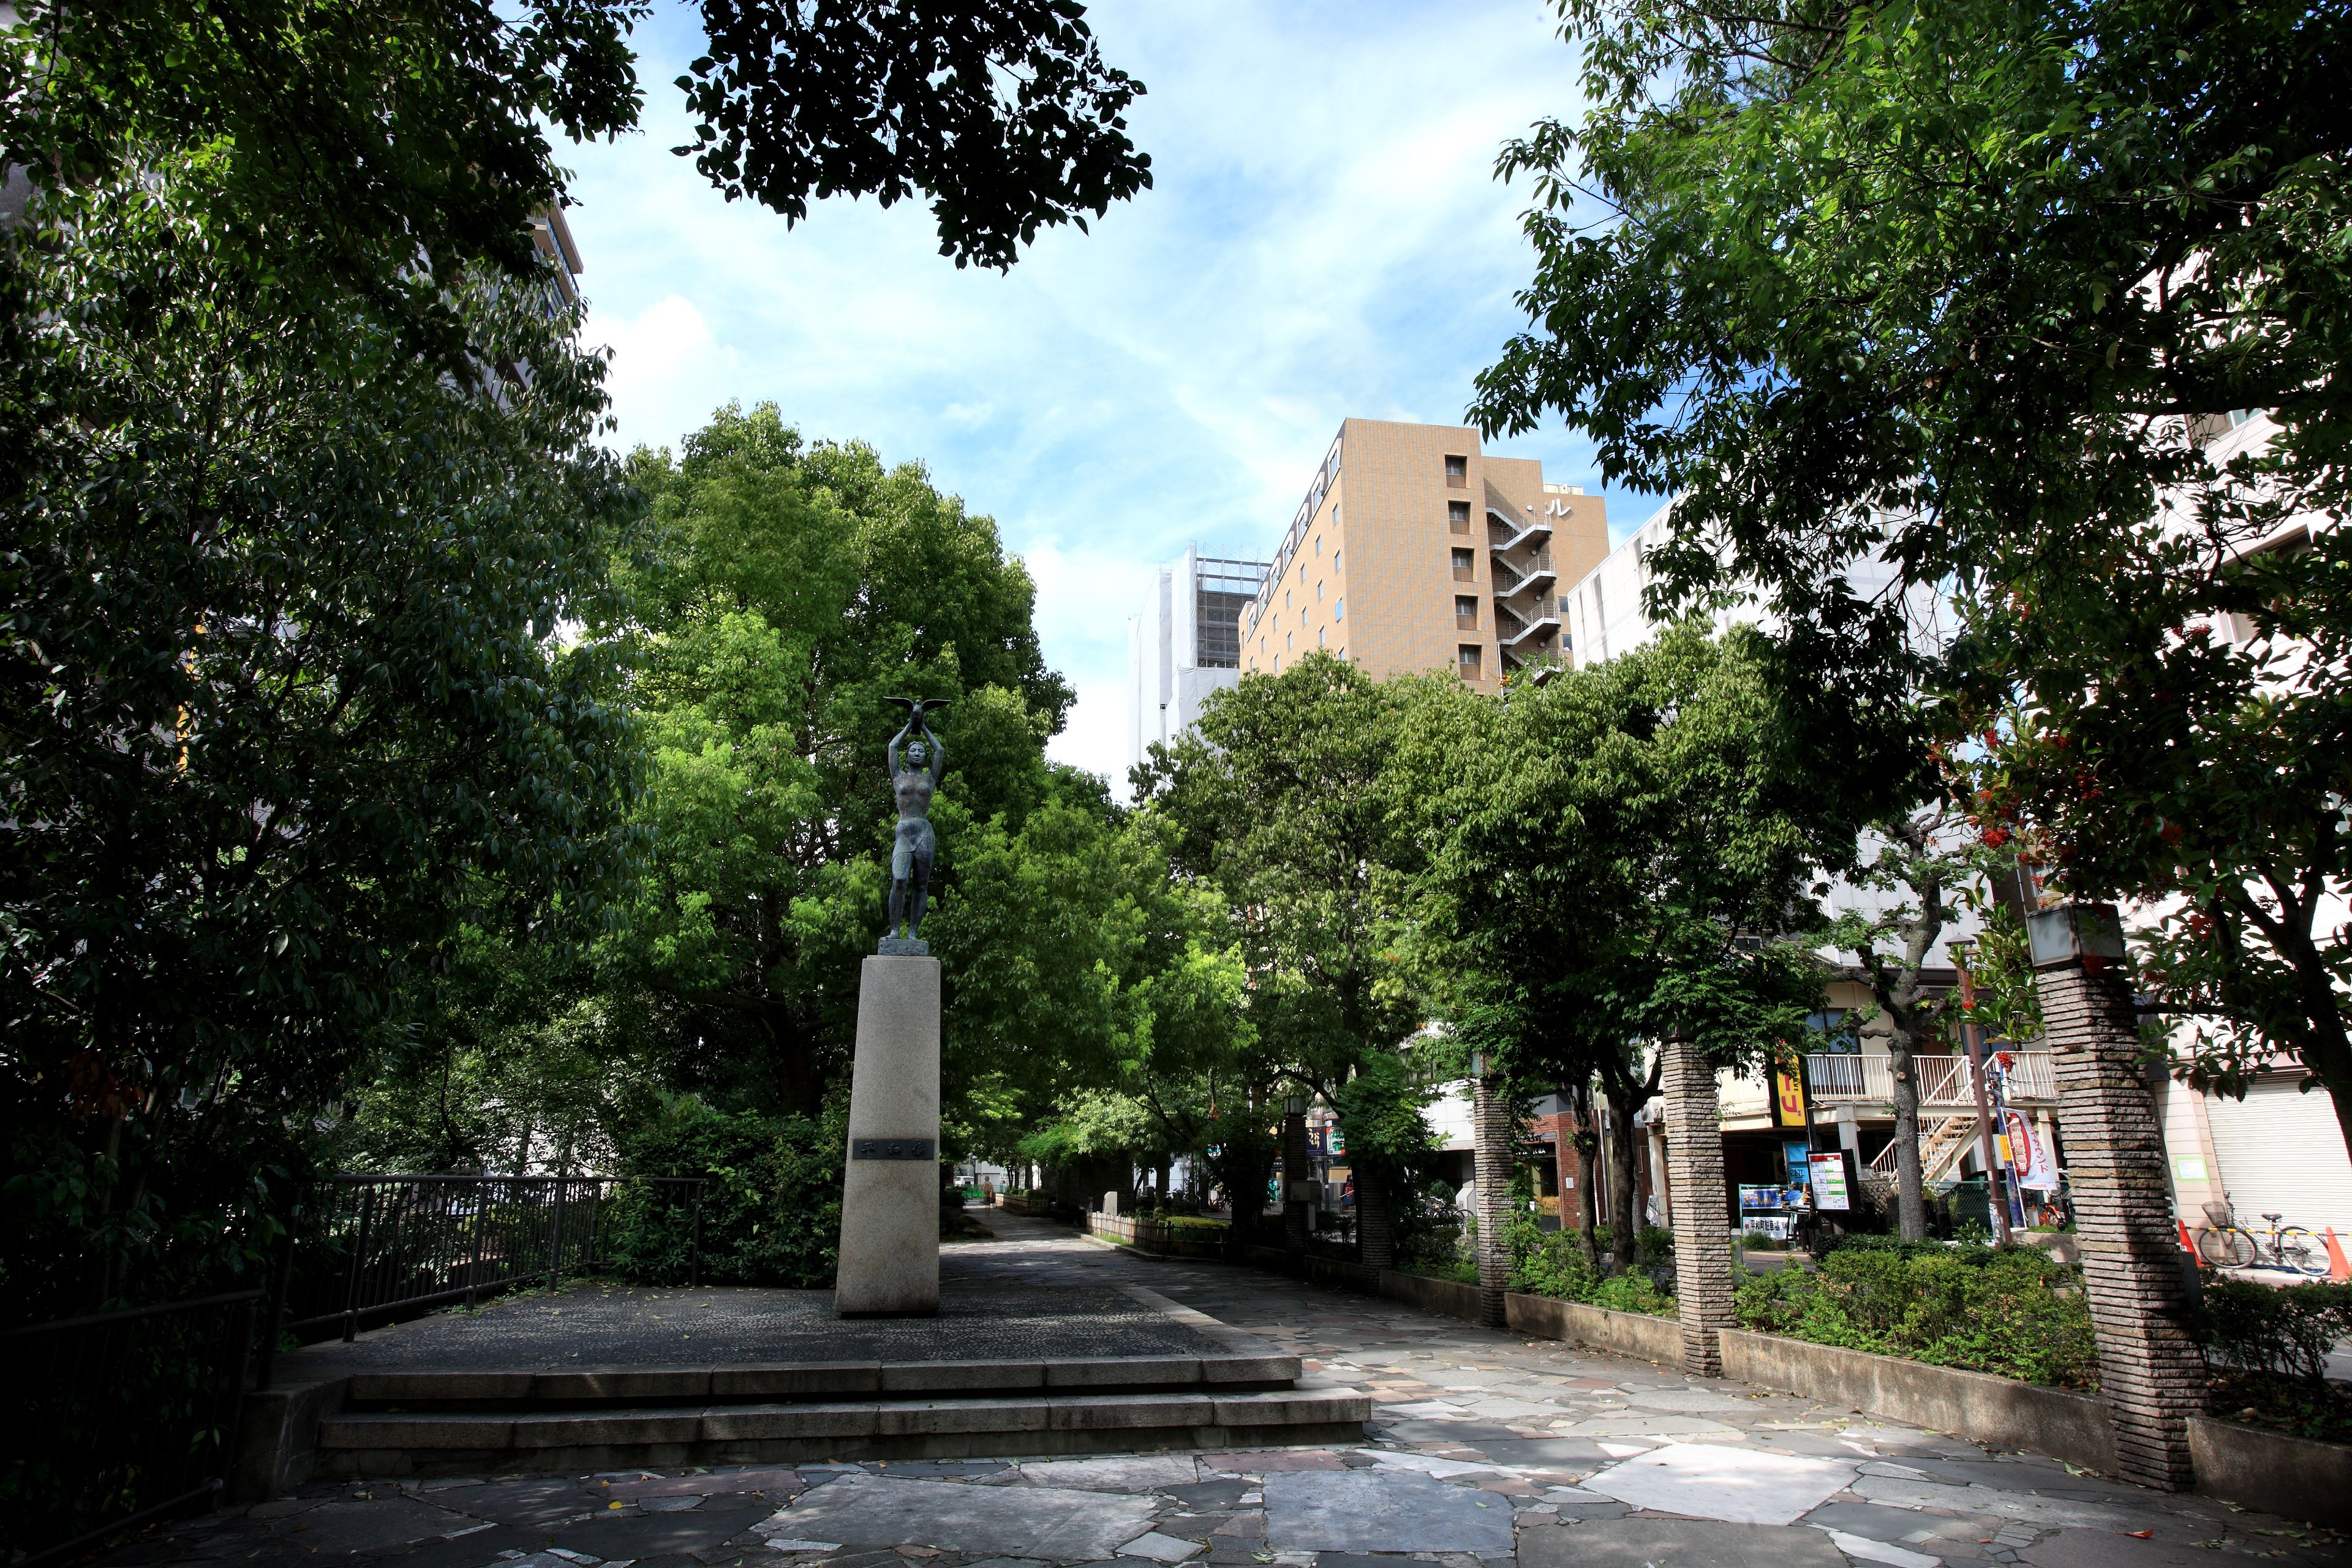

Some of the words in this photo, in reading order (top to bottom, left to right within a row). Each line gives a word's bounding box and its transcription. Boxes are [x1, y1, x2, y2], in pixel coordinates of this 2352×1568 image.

[1751, 1219, 1780, 1231] 平和町駐車場
